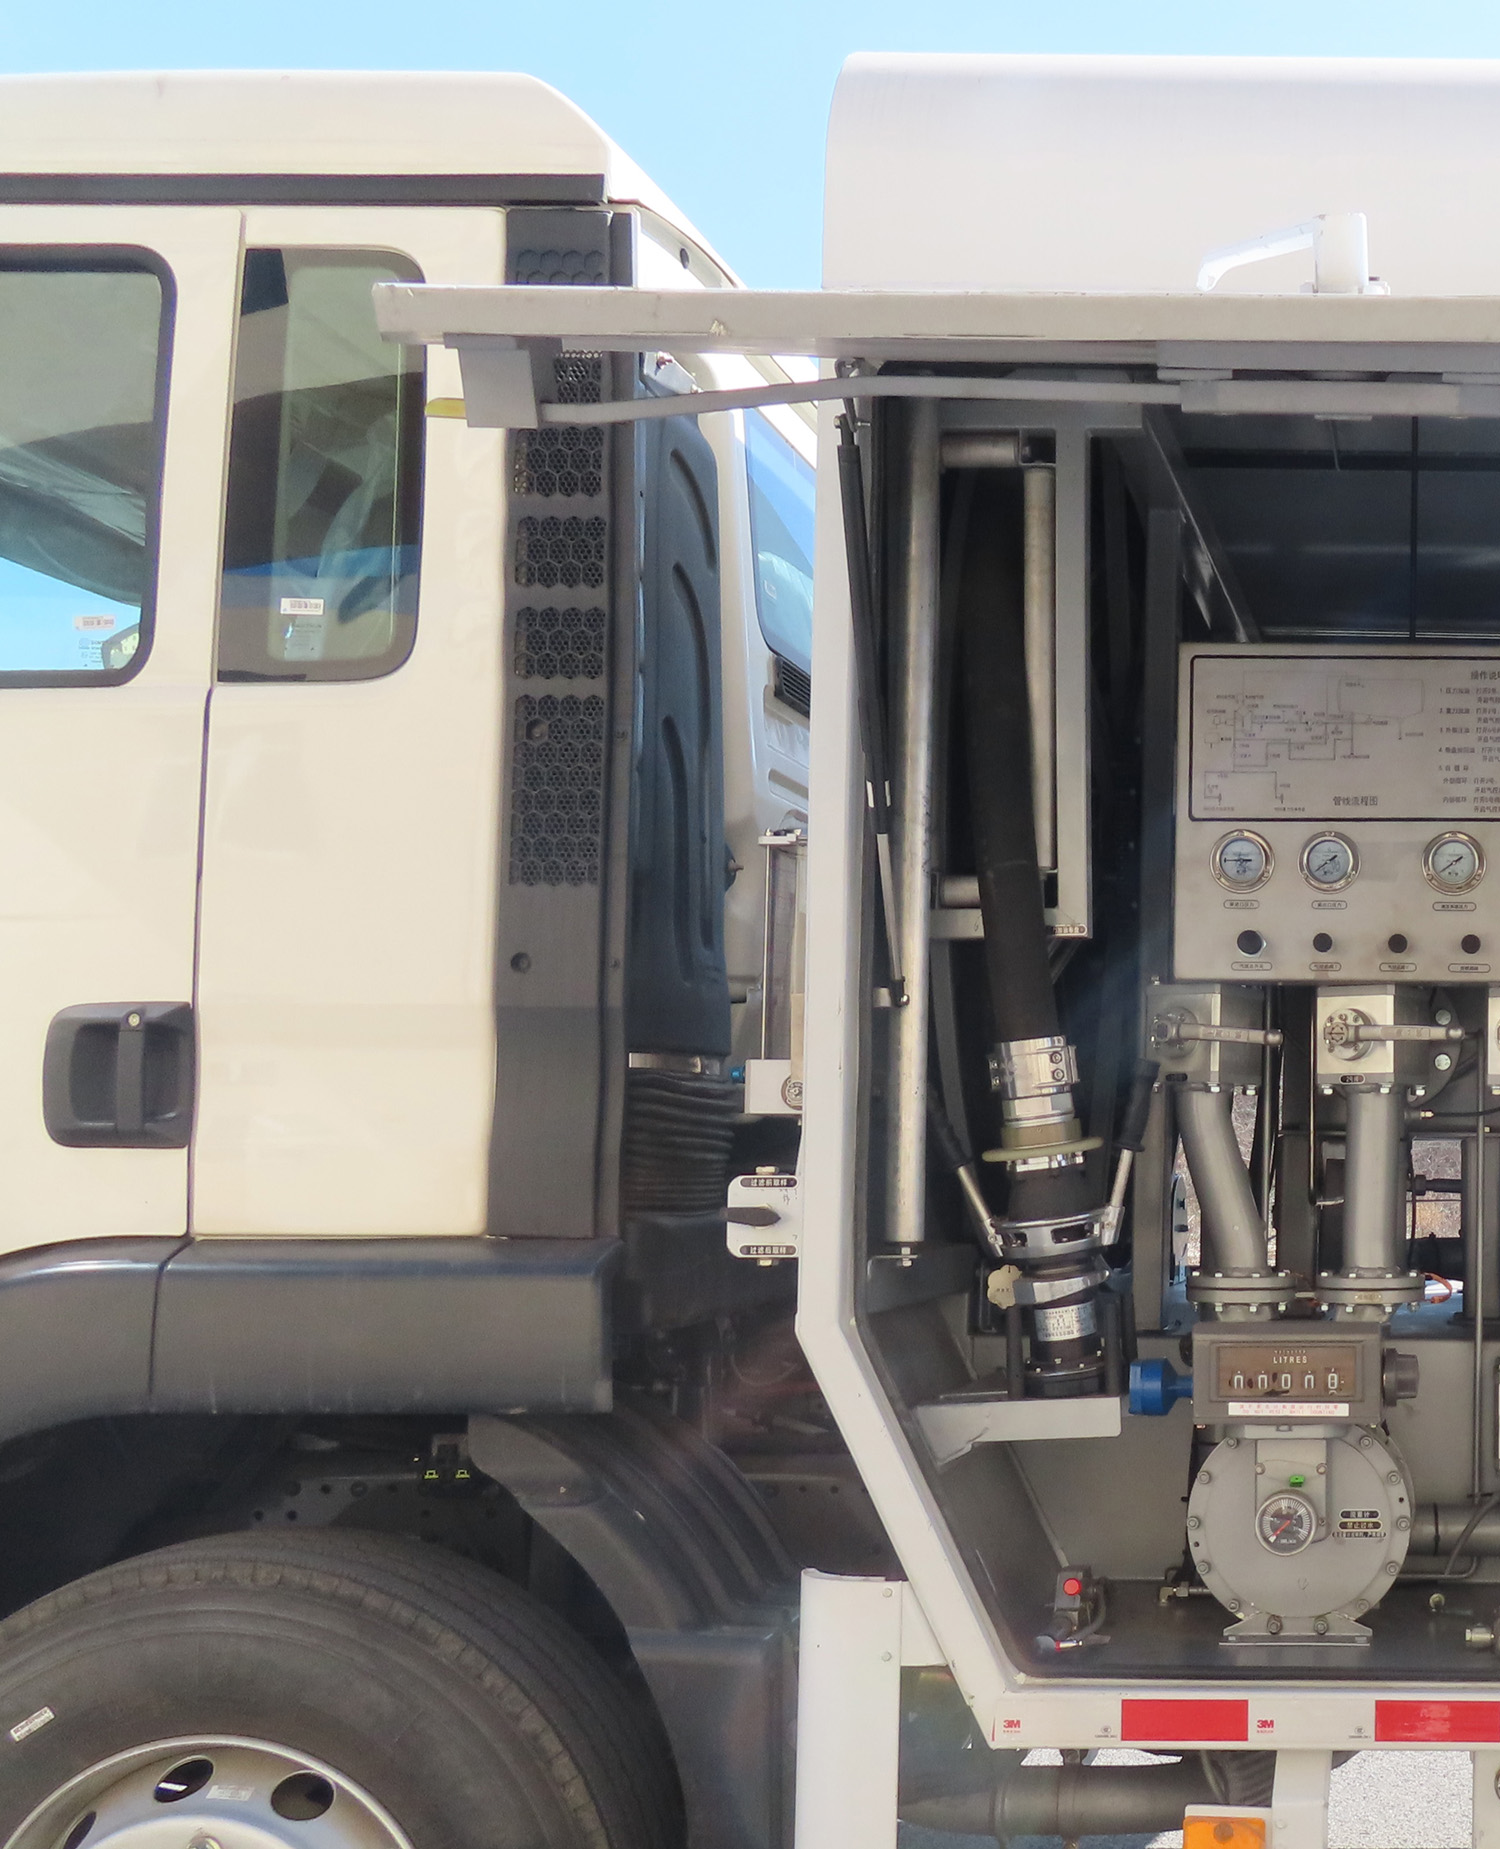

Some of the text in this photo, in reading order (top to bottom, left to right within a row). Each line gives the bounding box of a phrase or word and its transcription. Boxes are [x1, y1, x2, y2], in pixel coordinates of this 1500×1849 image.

[750, 1178, 788, 1187] 过滤前取样
[749, 1246, 786, 1255] 过滤后取样
[1273, 1355, 1308, 1364] LITRES
[1004, 1719, 1020, 1729] 3M
[1257, 1719, 1274, 1729] 3M
